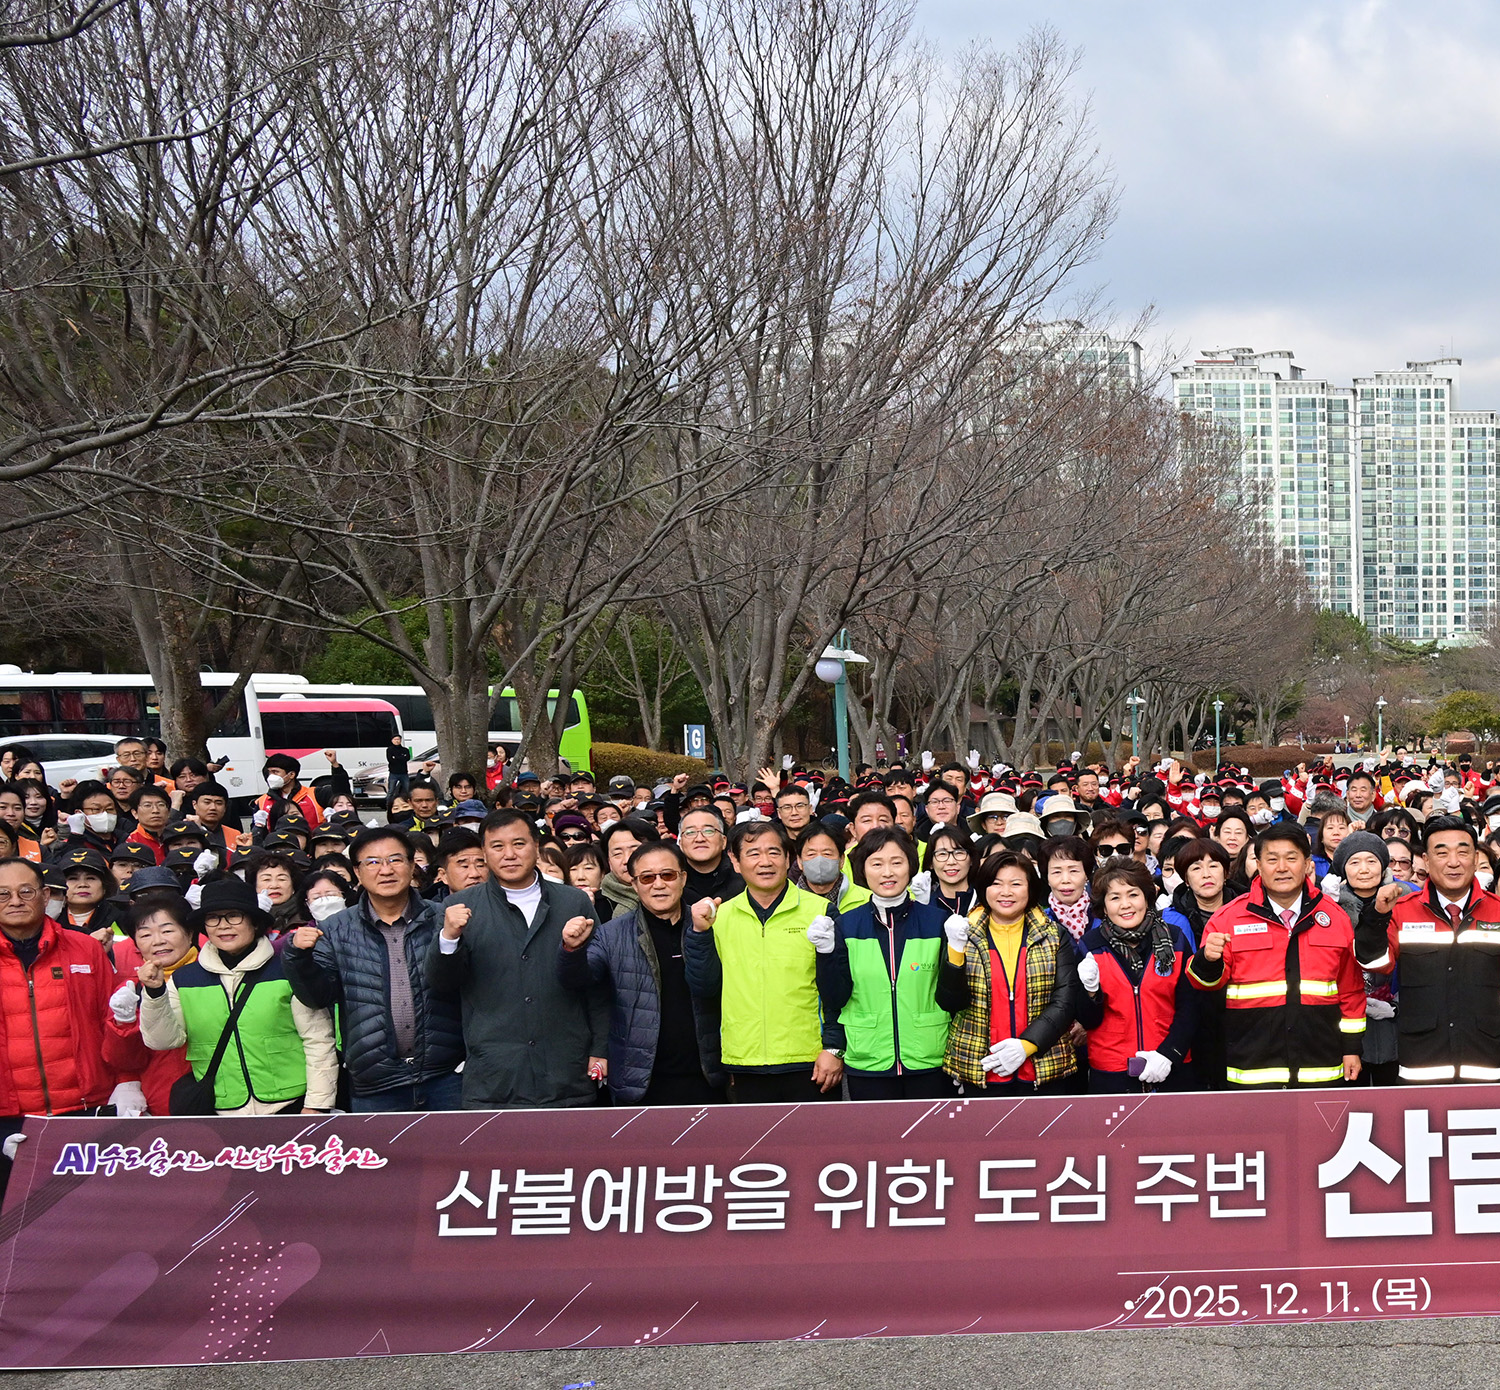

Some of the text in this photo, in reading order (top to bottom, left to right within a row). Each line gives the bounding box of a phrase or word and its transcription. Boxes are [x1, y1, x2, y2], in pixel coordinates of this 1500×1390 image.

[692, 728, 701, 749] G
[436, 1163, 790, 1237] 산불예방을
[814, 1159, 954, 1229] 위한
[974, 1155, 1107, 1223] 도심
[1134, 1151, 1267, 1222] 주변
[1143, 1277, 1432, 1319] 2025. 12. 11. (목)
